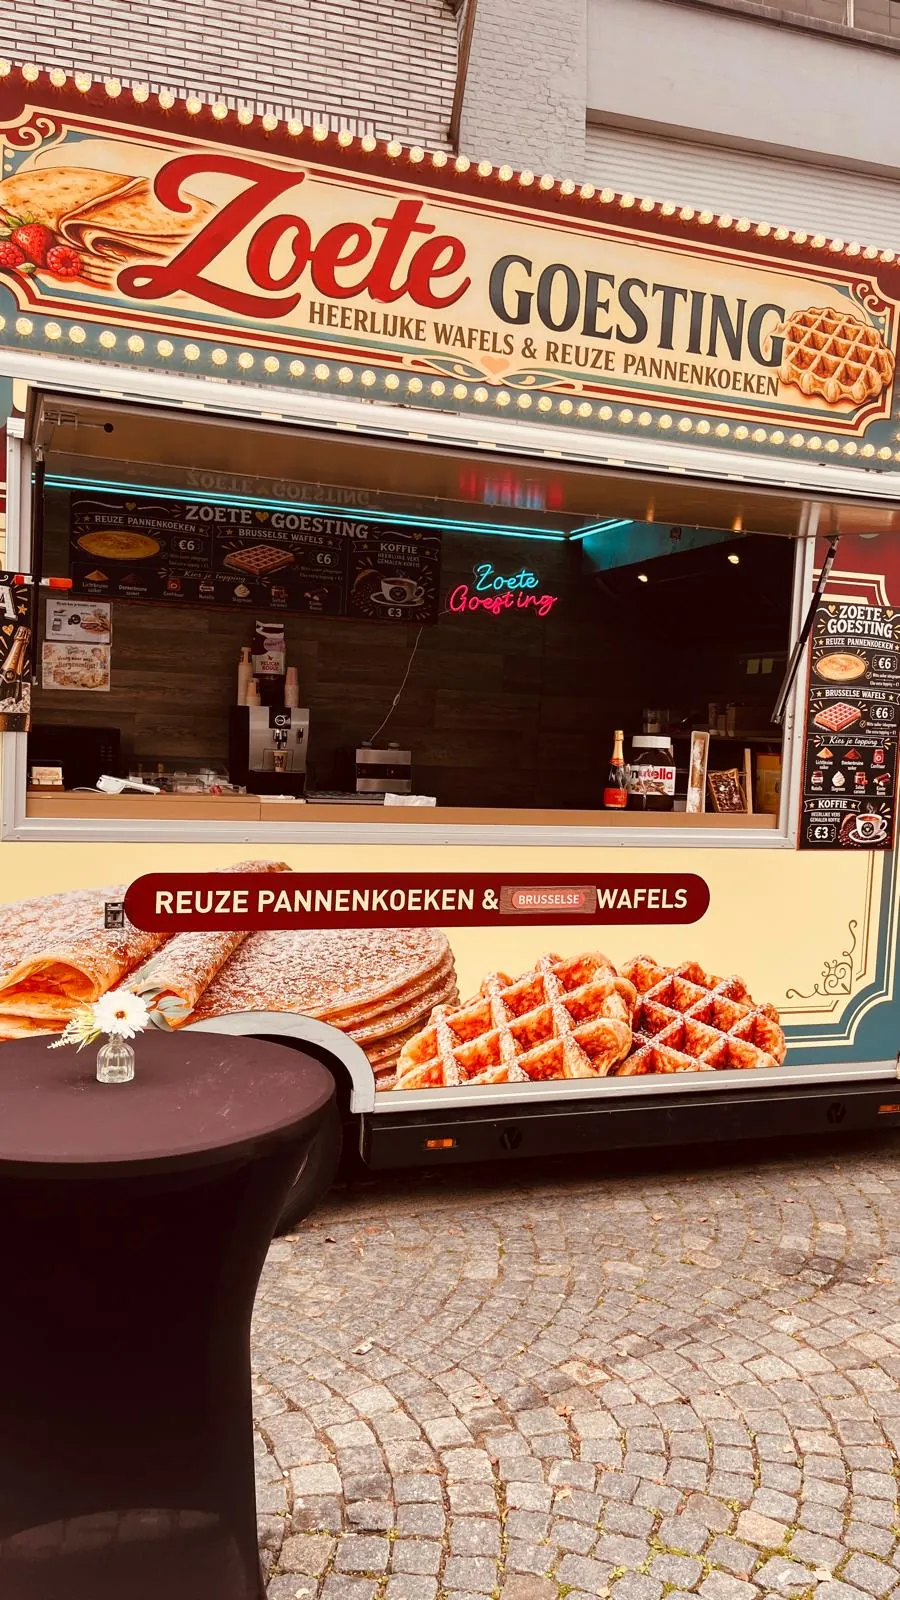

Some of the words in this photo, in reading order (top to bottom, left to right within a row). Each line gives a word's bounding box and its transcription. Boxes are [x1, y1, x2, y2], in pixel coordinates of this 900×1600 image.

[117, 153, 471, 319] Zoete
[489, 254, 786, 367] GOESTING
[308, 301, 426, 342] HEERLIJKE
[433, 323, 514, 355] WAFELS
[521, 337, 537, 359] &
[545, 342, 615, 371] REUZE
[623, 354, 779, 397] PANNENKOEKEN
[94, 515, 124, 524] REUZE
[127, 517, 196, 532] PANNENKOEKEN
[185, 505, 252, 524] ZOETE
[271, 513, 368, 539] GOESTING
[238, 529, 288, 540] BRUSSELSE
[291, 534, 324, 545] WAFELS
[178, 539, 195, 551] €6
[380, 542, 417, 554] KOFFIE
[316, 553, 332, 565] €6
[183, 570, 202, 578] Kies
[476, 563, 539, 591] Zoete
[449, 584, 558, 616] Goesting
[387, 608, 402, 617] €3
[839, 605, 882, 621] ZOETE
[827, 619, 893, 638] GOESTING
[825, 638, 845, 646] REUZE
[847, 638, 893, 650] PANNENKOEKEN
[878, 657, 891, 669] €6
[825, 689, 859, 698] BRUSSELSE
[862, 691, 886, 700] WAFELS
[875, 707, 888, 719] €6
[828, 736, 843, 745] Kies
[854, 737, 878, 747] topping
[632, 768, 673, 780] nutella
[818, 800, 848, 809] KOFFIE
[814, 827, 828, 839] €3
[155, 890, 249, 914] REUZE
[257, 889, 474, 913] PANNENKOEKEN
[482, 889, 499, 910] &
[518, 894, 580, 905] BRUSSELSE
[597, 888, 688, 909] WAFELS
